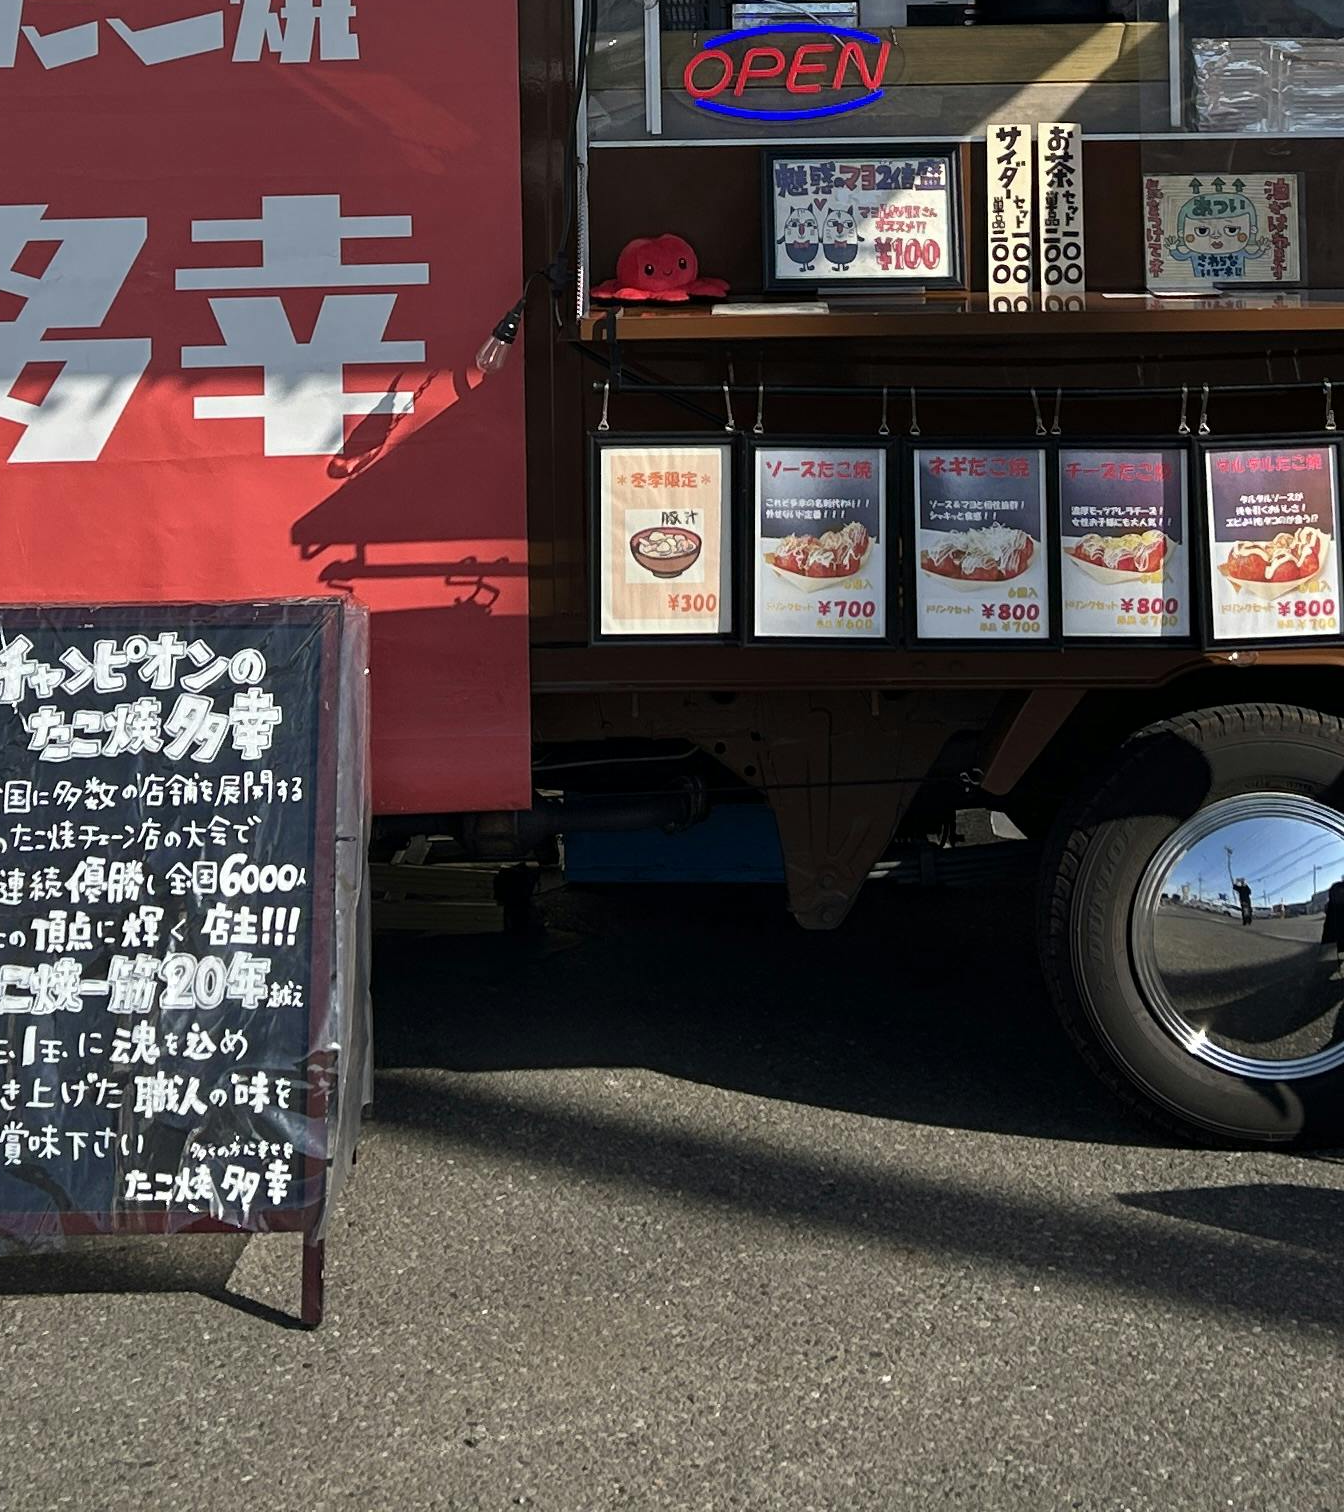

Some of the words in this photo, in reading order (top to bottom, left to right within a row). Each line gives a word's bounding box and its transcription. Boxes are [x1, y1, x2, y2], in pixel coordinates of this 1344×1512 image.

[683, 40, 892, 100] OPEN
[995, 126, 1026, 200] サイダー
[1044, 126, 1076, 189] お茶
[1191, 195, 1246, 217] あつい
[873, 236, 942, 271] ¥100
[630, 471, 698, 488] 冬季限定
[765, 460, 873, 479] ソースたこ焼
[661, 509, 699, 526] 豚汁
[667, 593, 717, 613] ¥300
[817, 600, 876, 618] ¥700
[981, 603, 1041, 621] ¥800
[1120, 597, 1180, 615] ¥800
[1277, 598, 1335, 618] ¥800
[26, 686, 283, 763] たこ焼多幸
